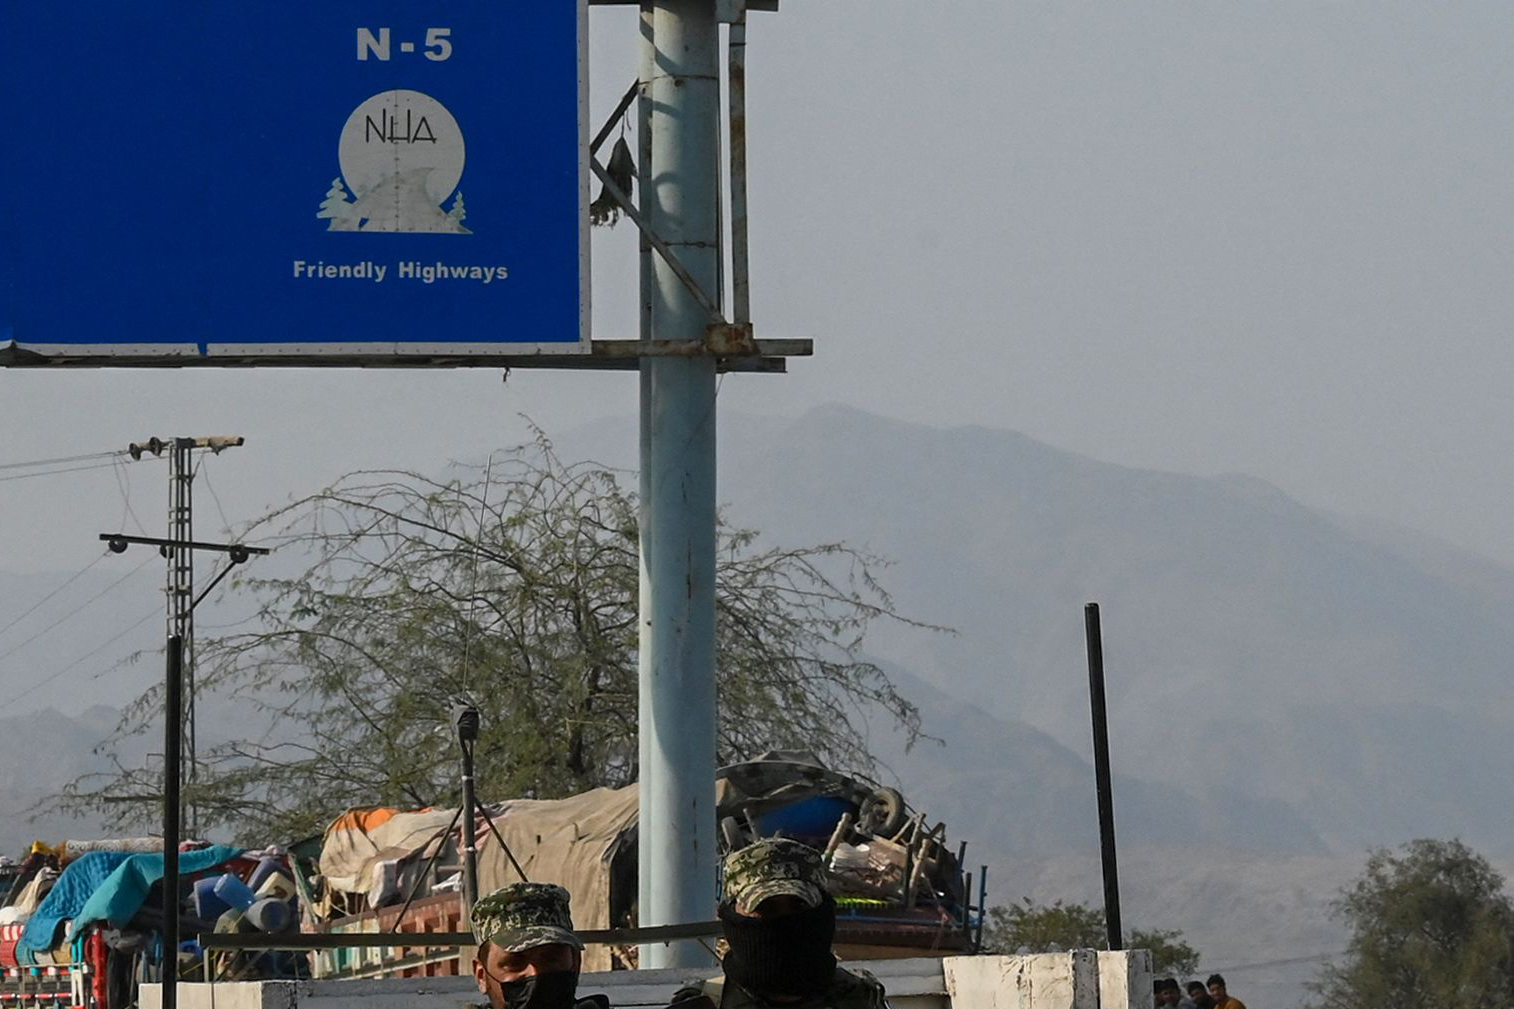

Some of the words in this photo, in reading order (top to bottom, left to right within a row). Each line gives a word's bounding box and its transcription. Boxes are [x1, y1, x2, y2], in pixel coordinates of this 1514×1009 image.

[365, 107, 438, 145] NHA
[293, 260, 387, 282] Friendly
[398, 261, 509, 284] Highways
